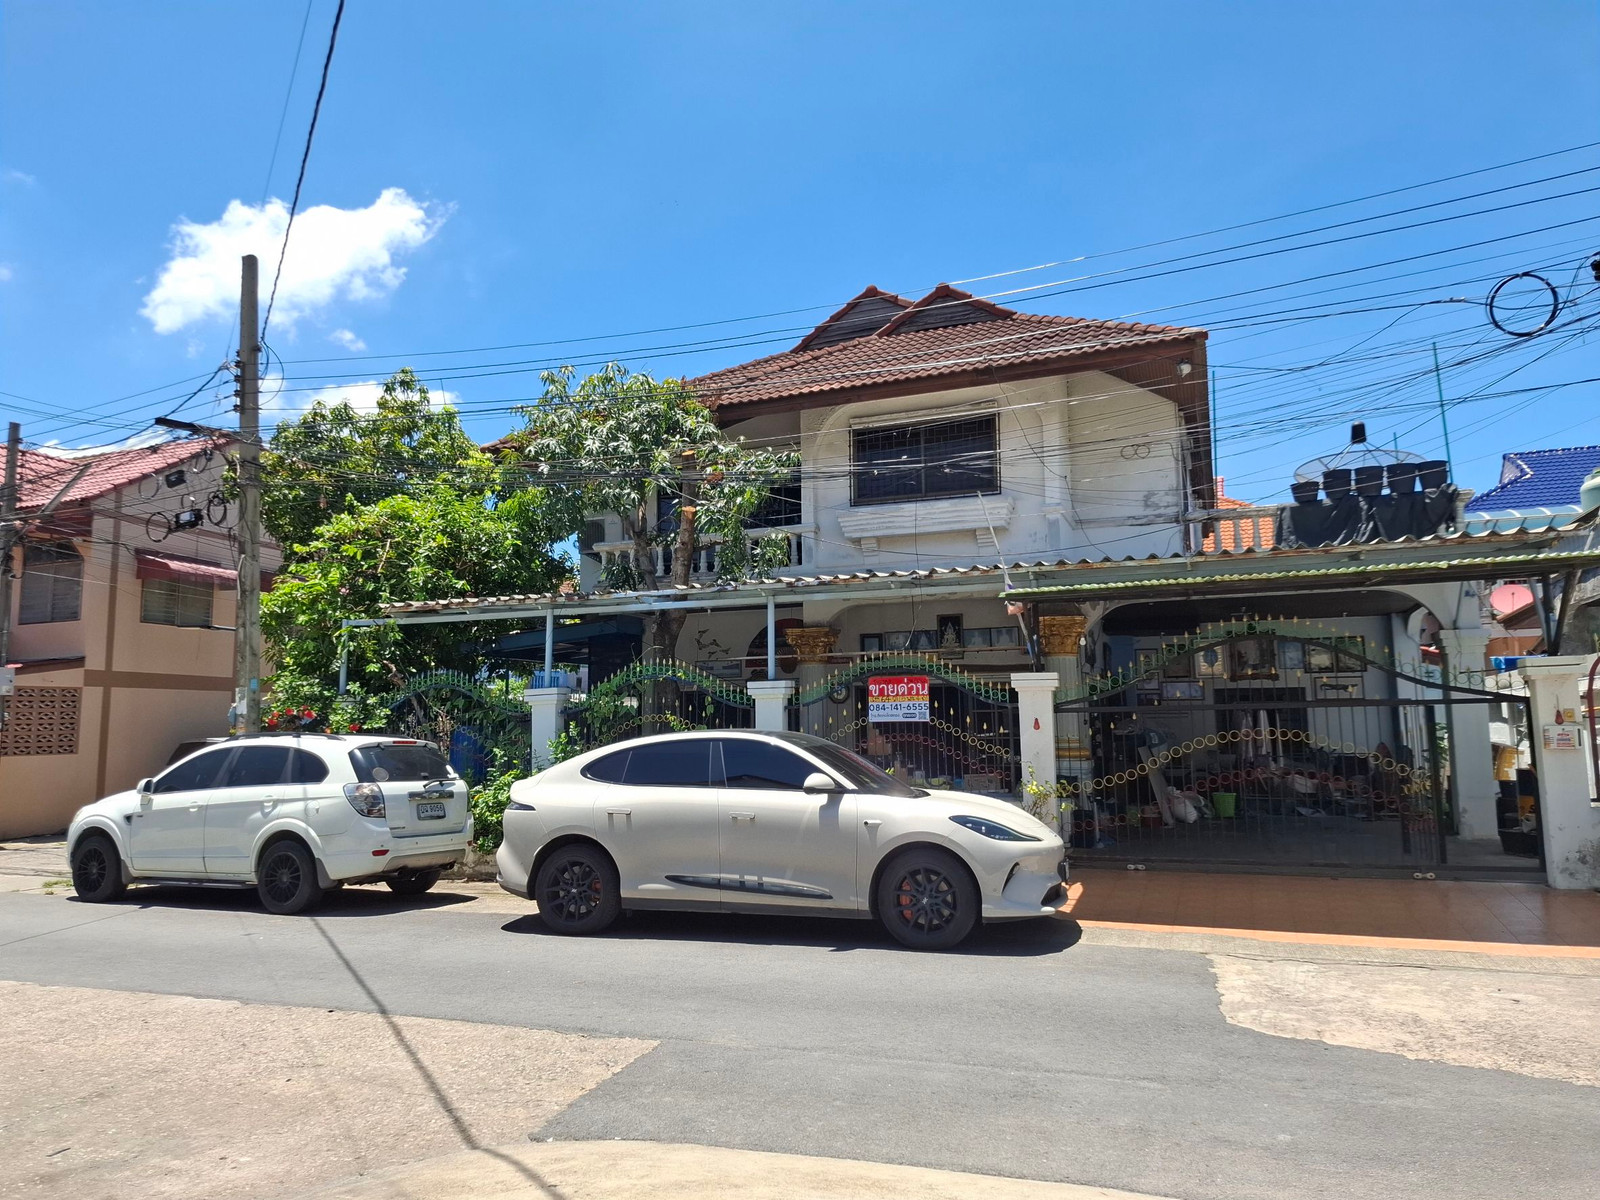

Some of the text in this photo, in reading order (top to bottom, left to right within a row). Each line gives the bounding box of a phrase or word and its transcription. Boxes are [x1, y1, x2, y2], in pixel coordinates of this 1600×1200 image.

[869, 678, 928, 696] ขายด่วน
[869, 703, 929, 711] 084-141-6555
